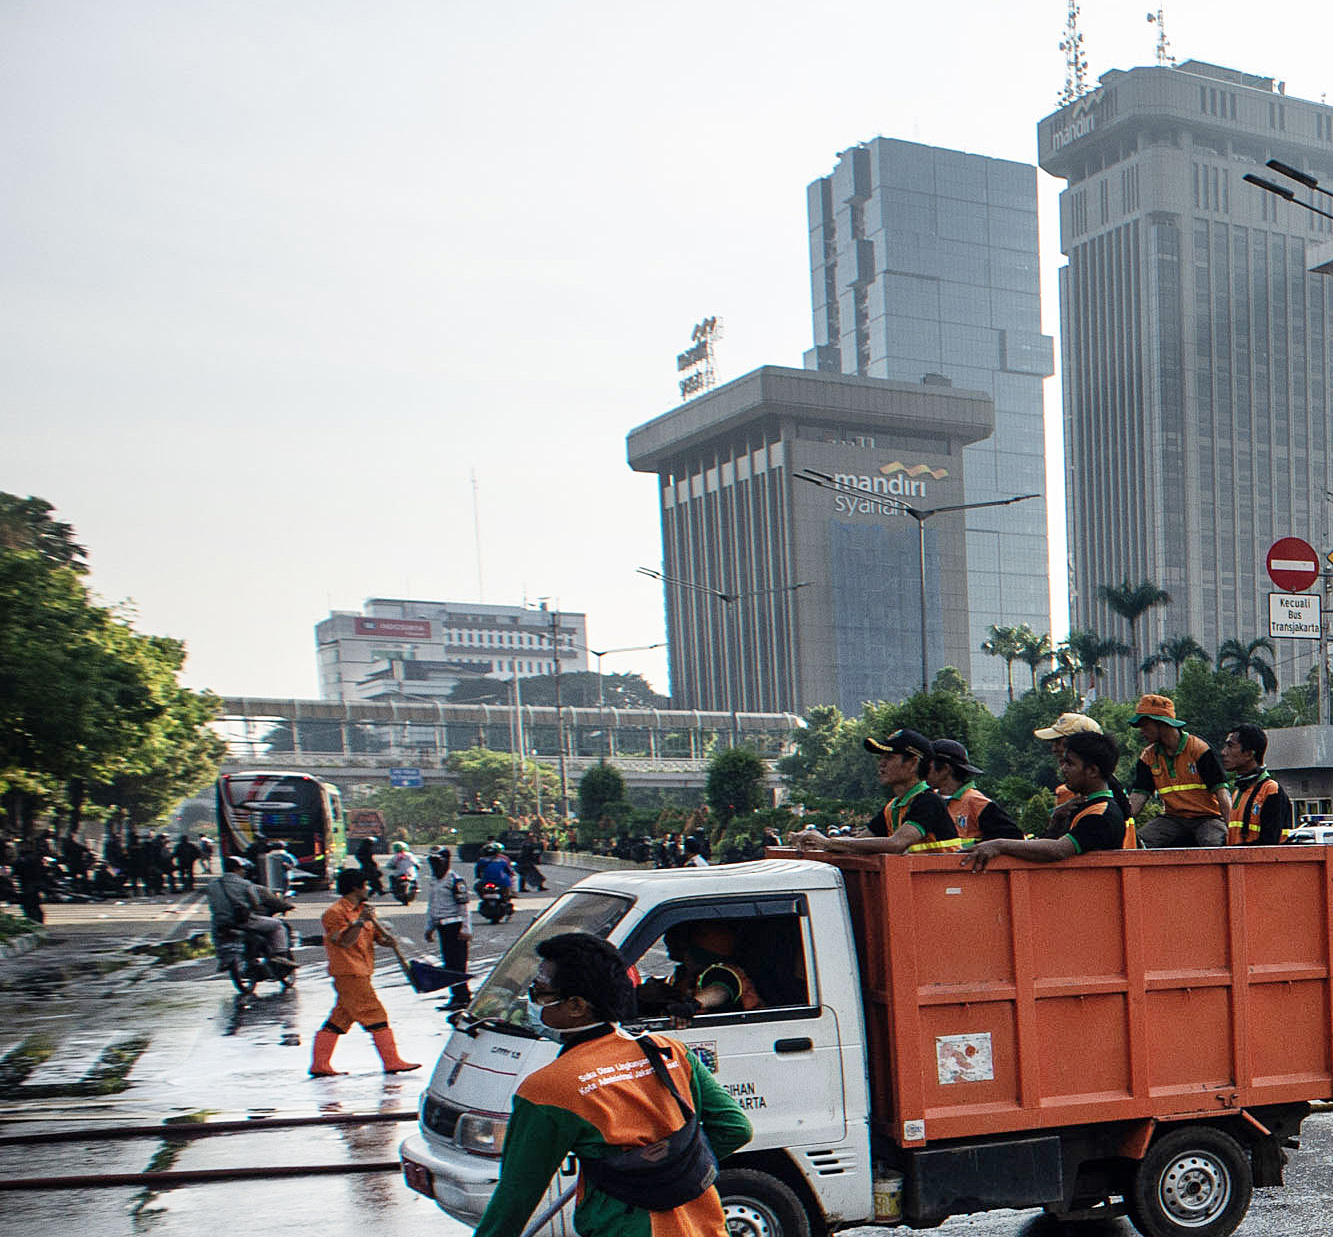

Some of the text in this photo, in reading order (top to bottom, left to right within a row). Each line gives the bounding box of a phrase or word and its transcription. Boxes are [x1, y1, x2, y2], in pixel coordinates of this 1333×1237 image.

[834, 472, 927, 497] mandiri
[1280, 598, 1311, 608] Kecuali
[1288, 610, 1302, 620] Bus
[1272, 622, 1320, 634] Transjakarta
[735, 1096, 767, 1110] ARTA
